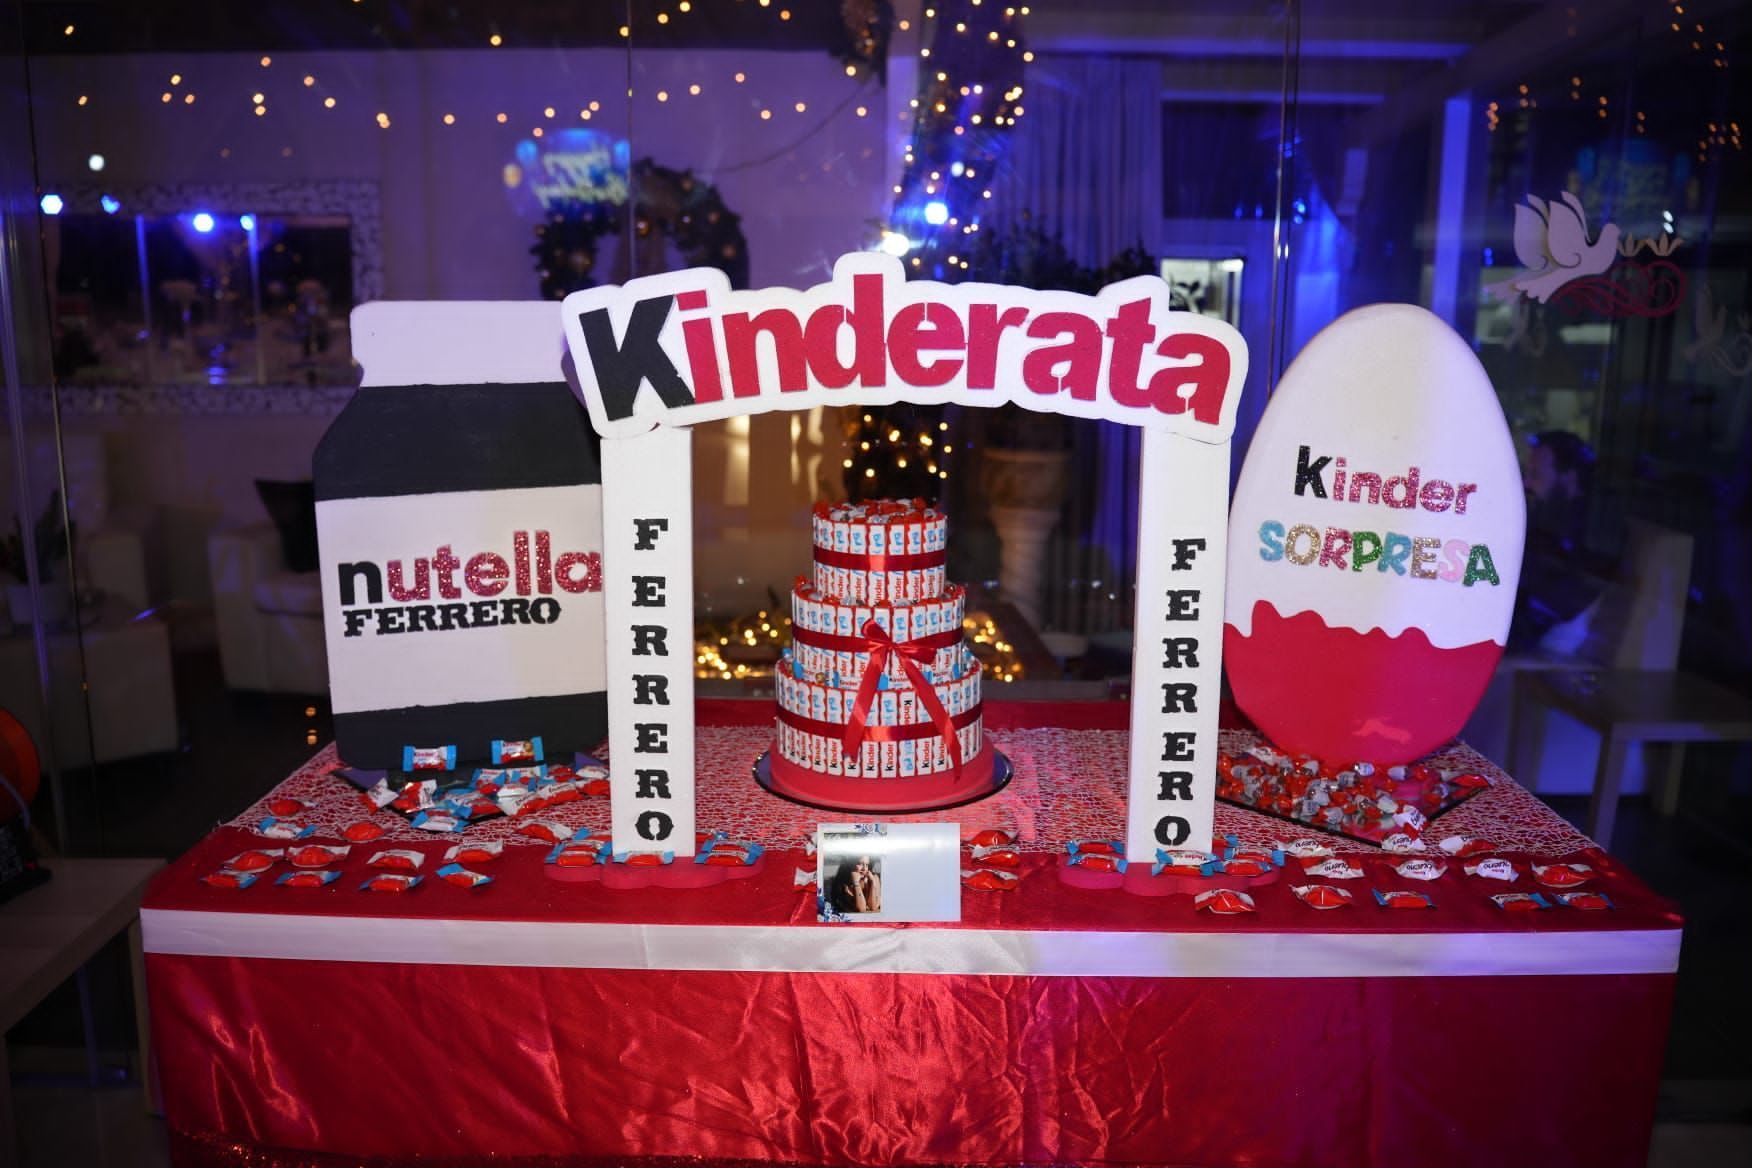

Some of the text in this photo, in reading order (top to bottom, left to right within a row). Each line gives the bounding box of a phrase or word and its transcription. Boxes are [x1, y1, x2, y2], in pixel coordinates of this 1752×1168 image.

[579, 274, 1231, 425] Kinderata
[1294, 445, 1477, 515] Kinder
[338, 530, 603, 605] nutella
[1259, 520, 1500, 587] SORPRESA
[342, 597, 561, 637] FERRERO
[631, 518, 674, 841] FERRERO
[904, 700, 913, 724] Kinde
[1154, 538, 1207, 846] FERRERO
